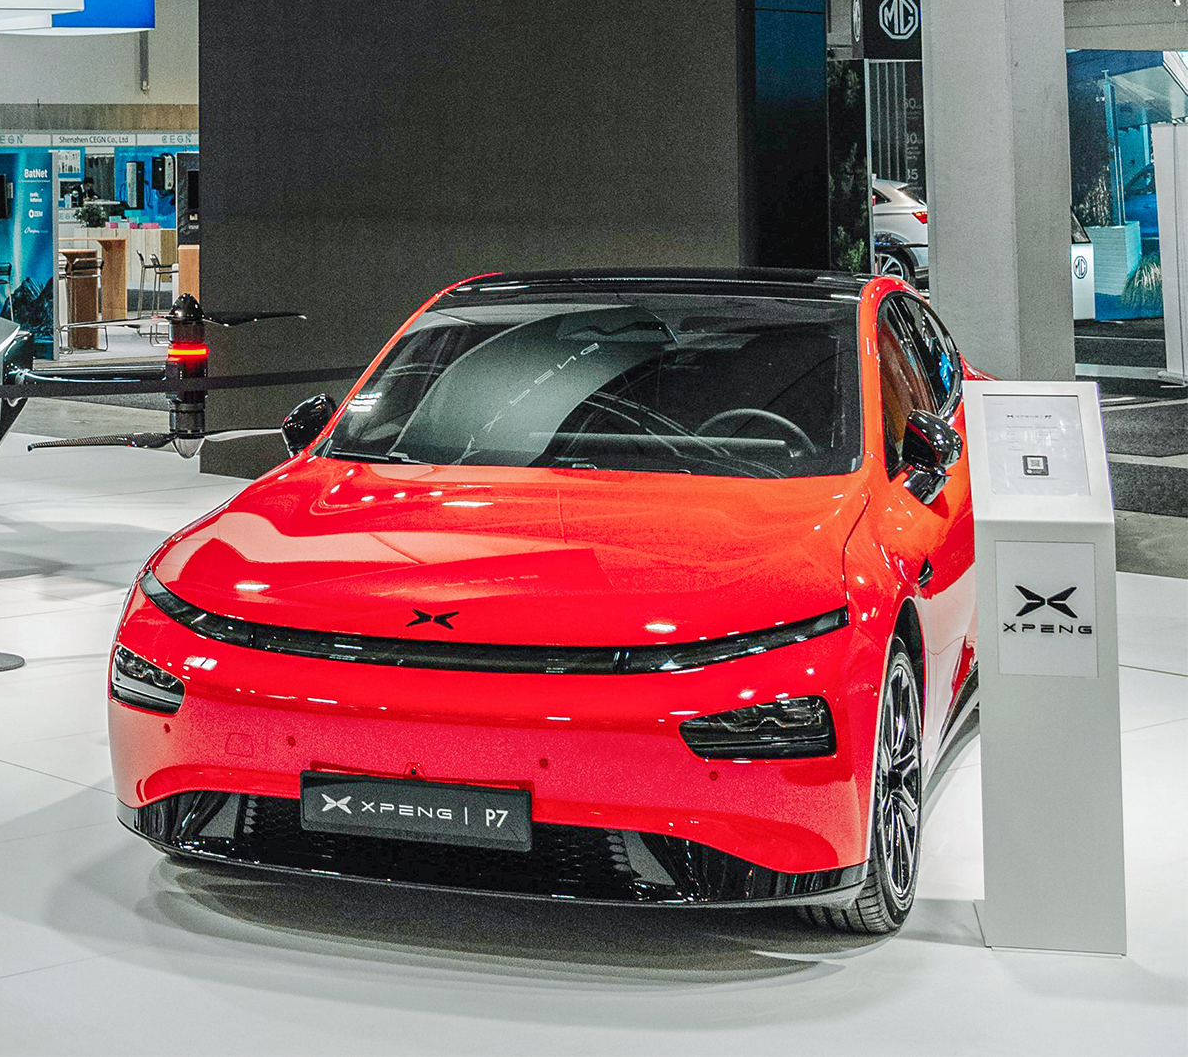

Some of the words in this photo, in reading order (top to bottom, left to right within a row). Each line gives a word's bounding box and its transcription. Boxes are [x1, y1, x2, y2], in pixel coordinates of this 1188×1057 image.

[161, 134, 192, 143] CEGN
[24, 168, 48, 178] BatNet
[1003, 623, 1093, 634] XPENG
[361, 801, 452, 820] XPENG
[486, 808, 509, 827] P7
